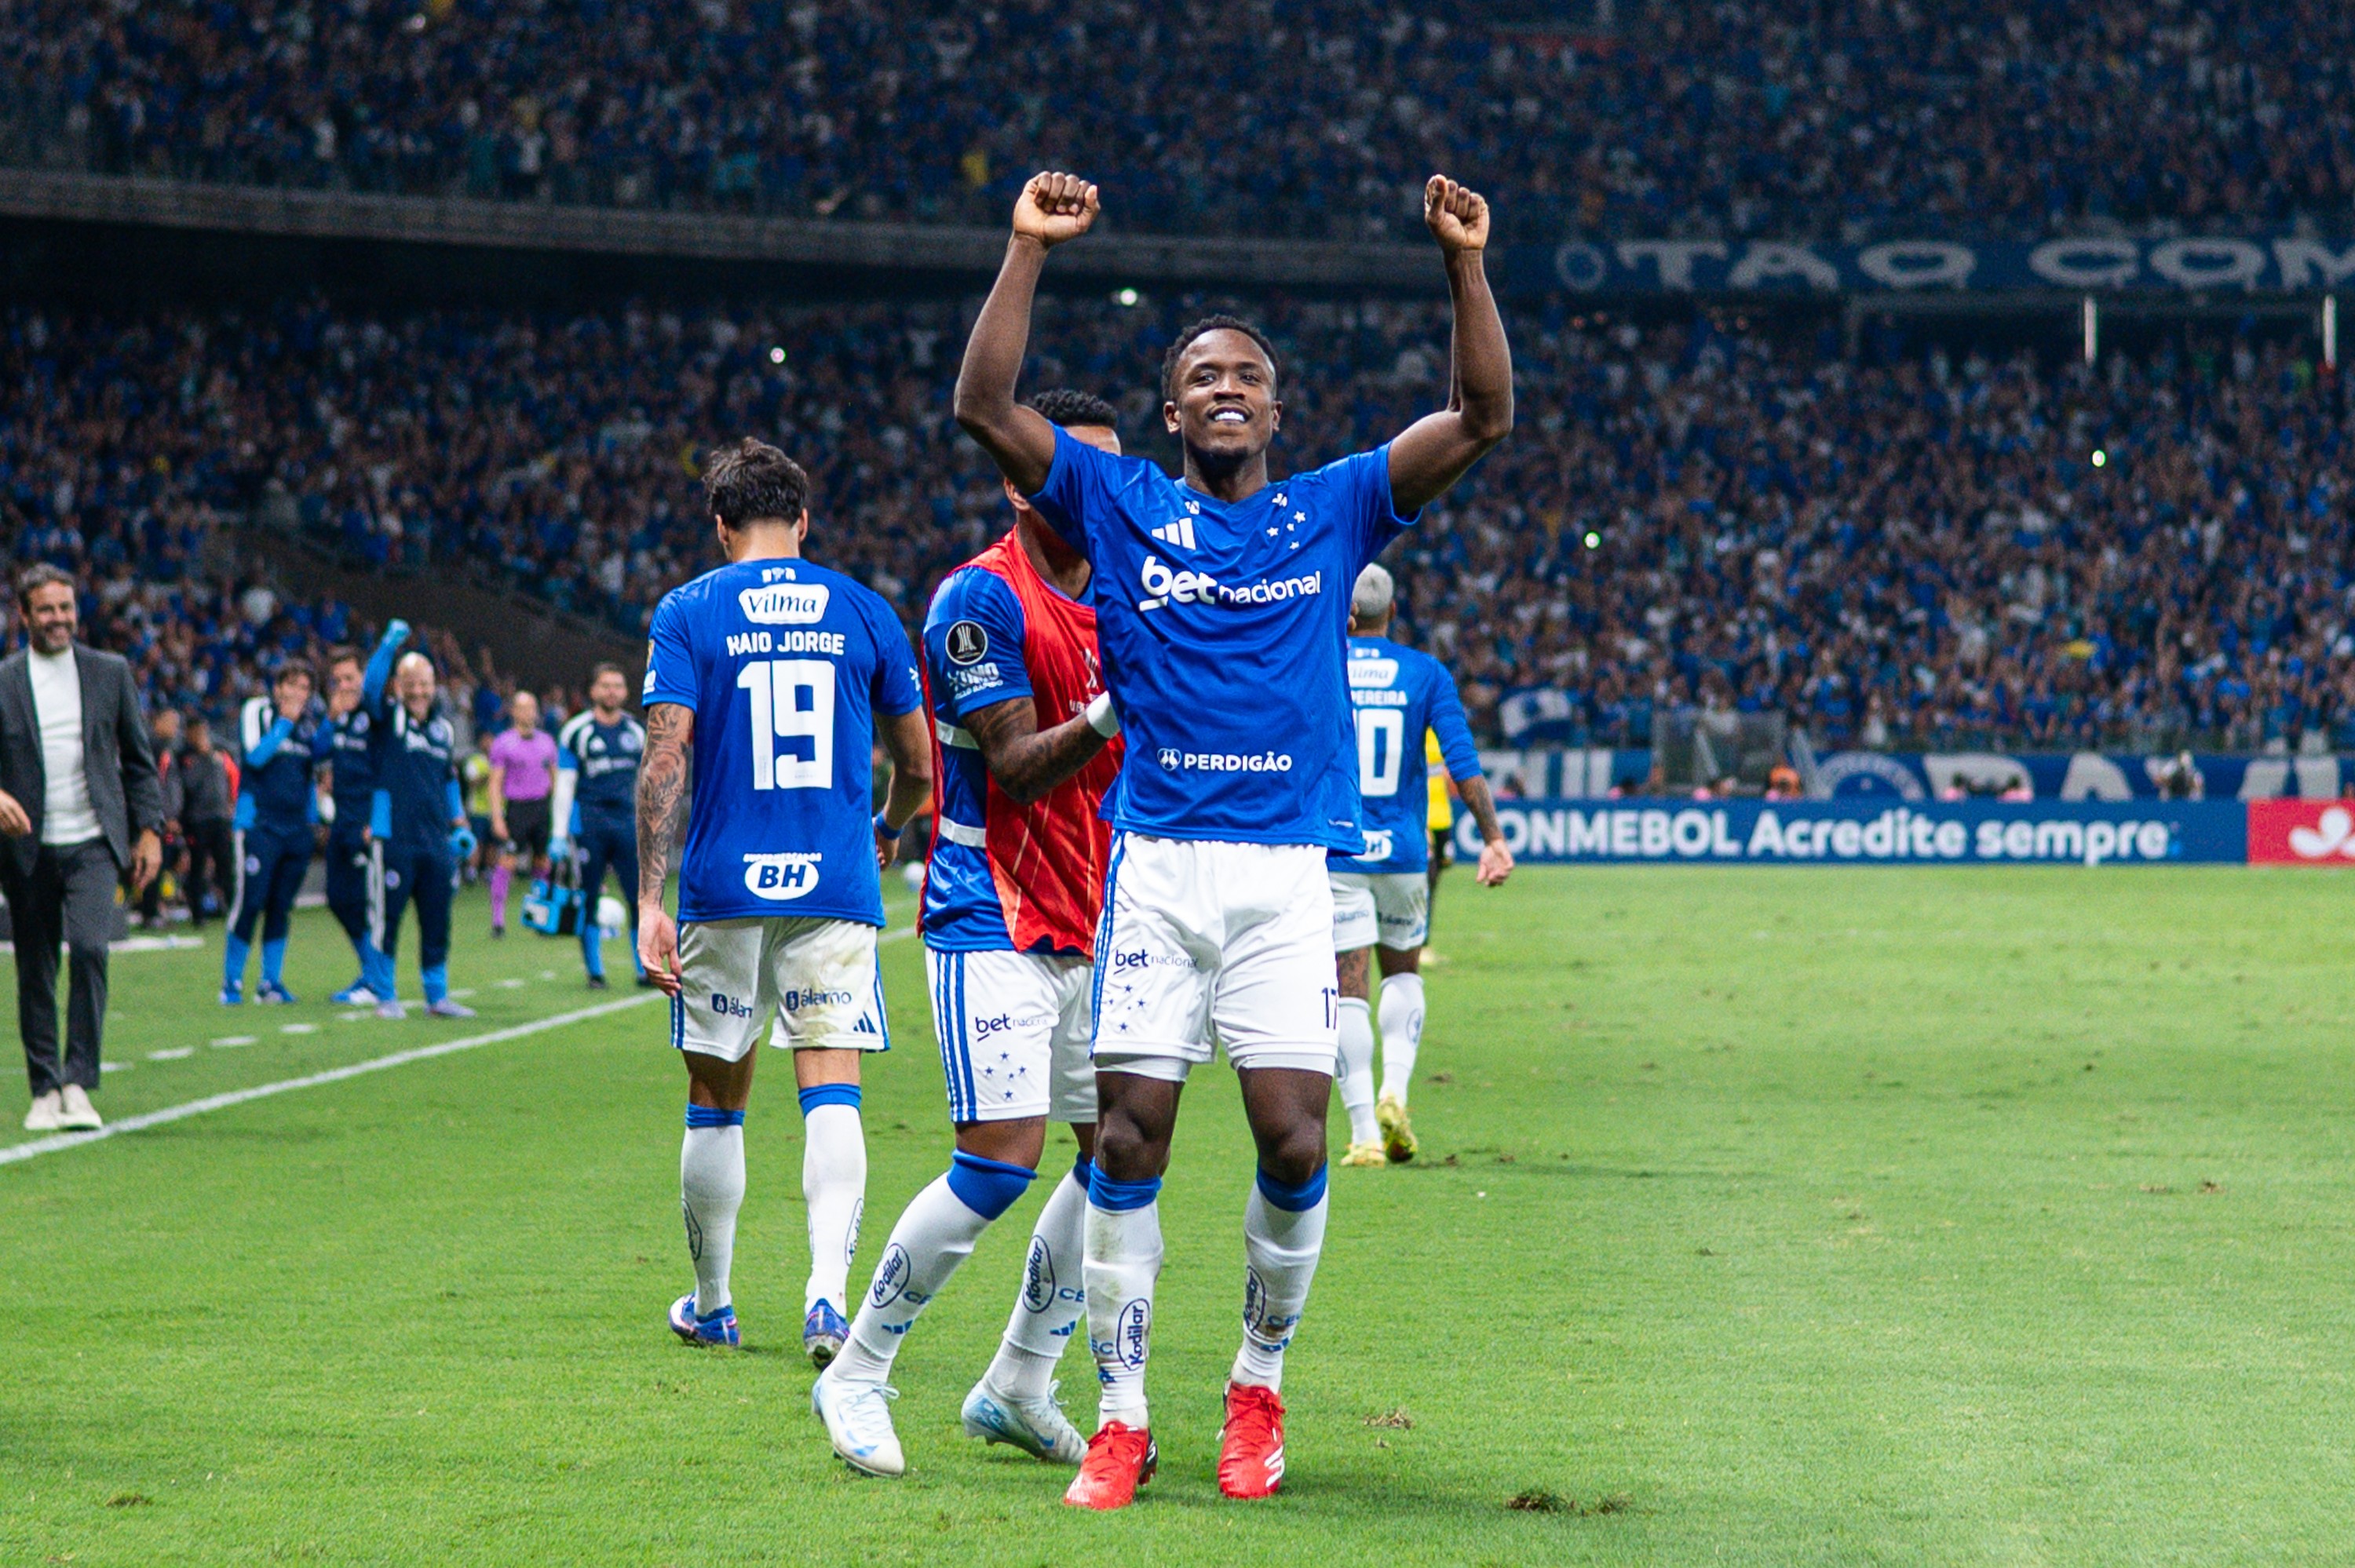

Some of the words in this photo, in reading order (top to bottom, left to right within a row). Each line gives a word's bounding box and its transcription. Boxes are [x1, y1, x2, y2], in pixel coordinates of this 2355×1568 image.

[748, 593, 816, 613] Vilma
[777, 631, 845, 655] JORGE
[1352, 667, 1389, 679] ilma
[737, 659, 835, 789] 19
[1184, 751, 1292, 771] PERDIGÃO
[1353, 708, 1404, 796] 0
[1748, 807, 1966, 858] Acredite
[758, 864, 807, 888] BH
[801, 988, 852, 1007] álamo
[1127, 1304, 1145, 1366] Kodilar
